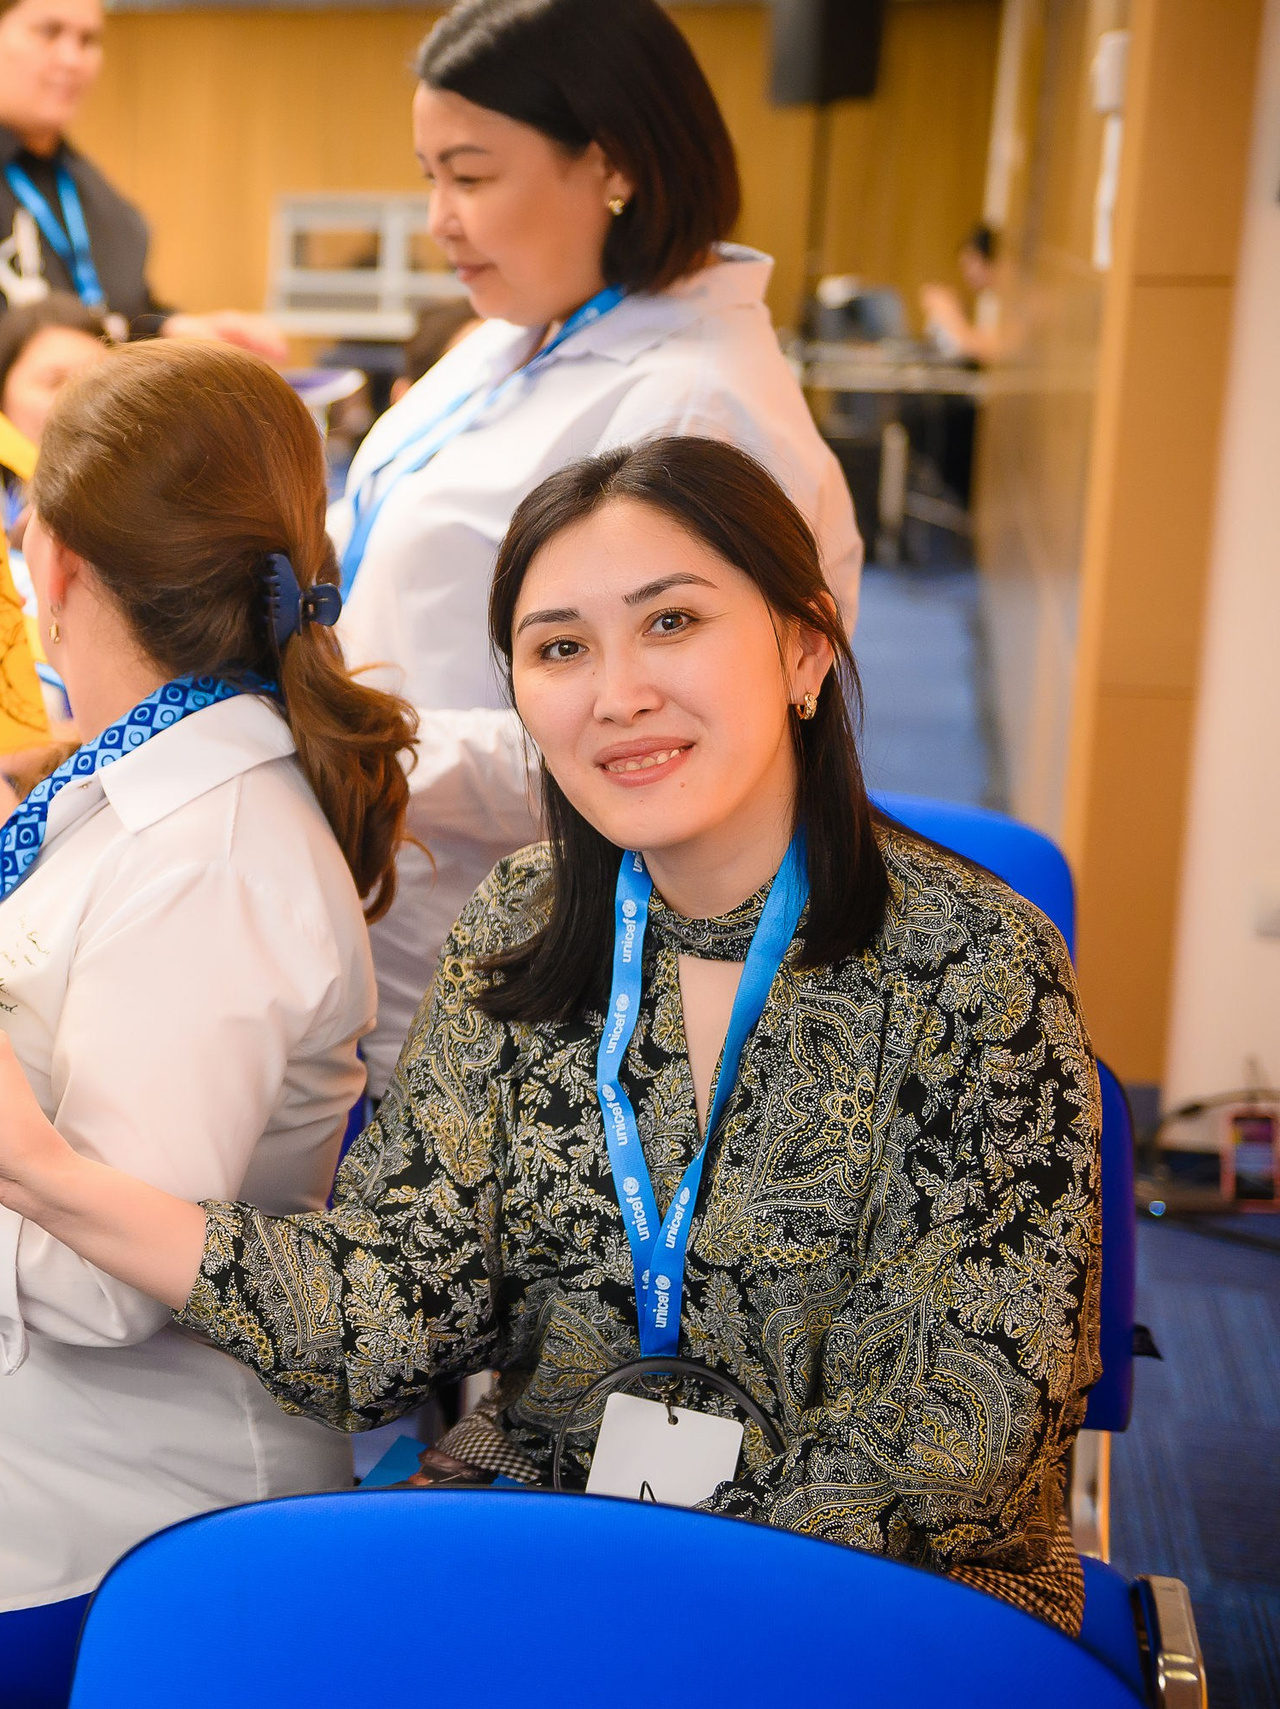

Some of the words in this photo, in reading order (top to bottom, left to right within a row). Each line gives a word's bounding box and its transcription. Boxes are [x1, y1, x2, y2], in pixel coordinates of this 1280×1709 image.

[622, 918, 637, 963] unicef
[606, 1012, 627, 1054] unicef
[606, 1102, 628, 1146] unicef
[626, 1196, 650, 1242] unicef
[665, 1203, 686, 1249] unicef
[652, 1290, 669, 1328] unicef
